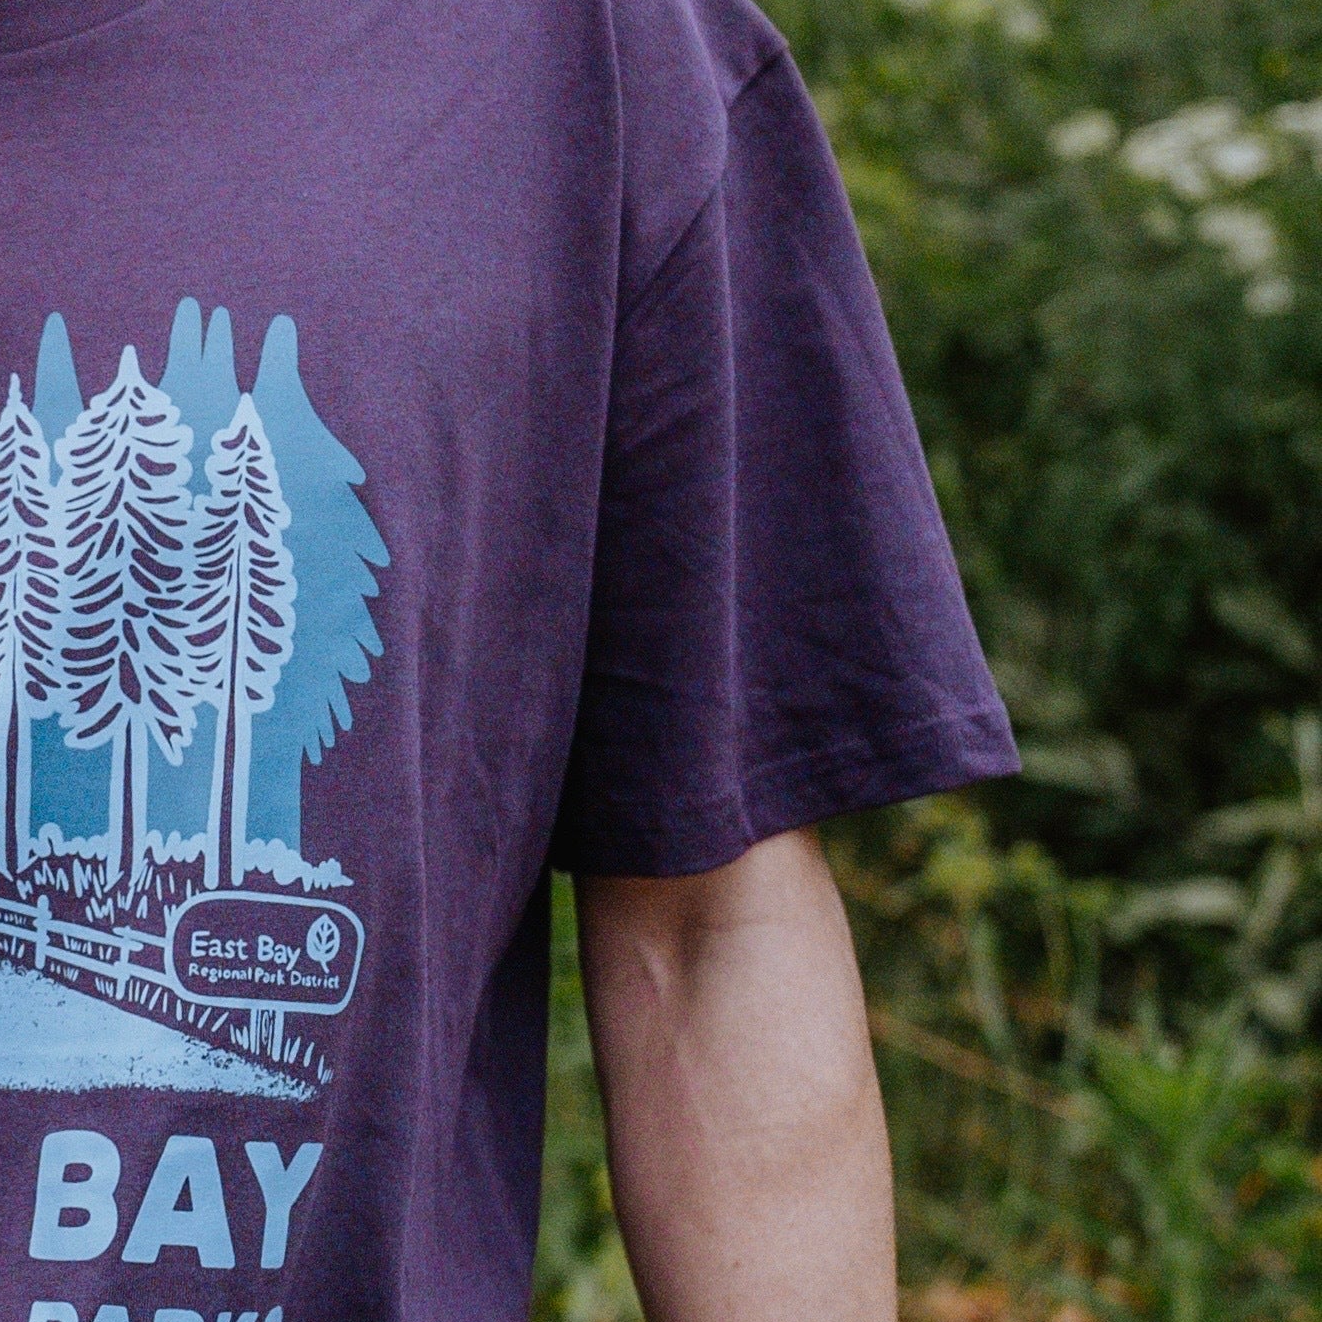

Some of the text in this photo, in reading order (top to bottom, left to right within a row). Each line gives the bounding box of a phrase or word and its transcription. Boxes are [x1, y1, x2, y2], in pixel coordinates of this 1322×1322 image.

[190, 930, 301, 972] East Bay
[188, 963, 340, 989] Regional Park District
[28, 1129, 324, 1270] BAY
